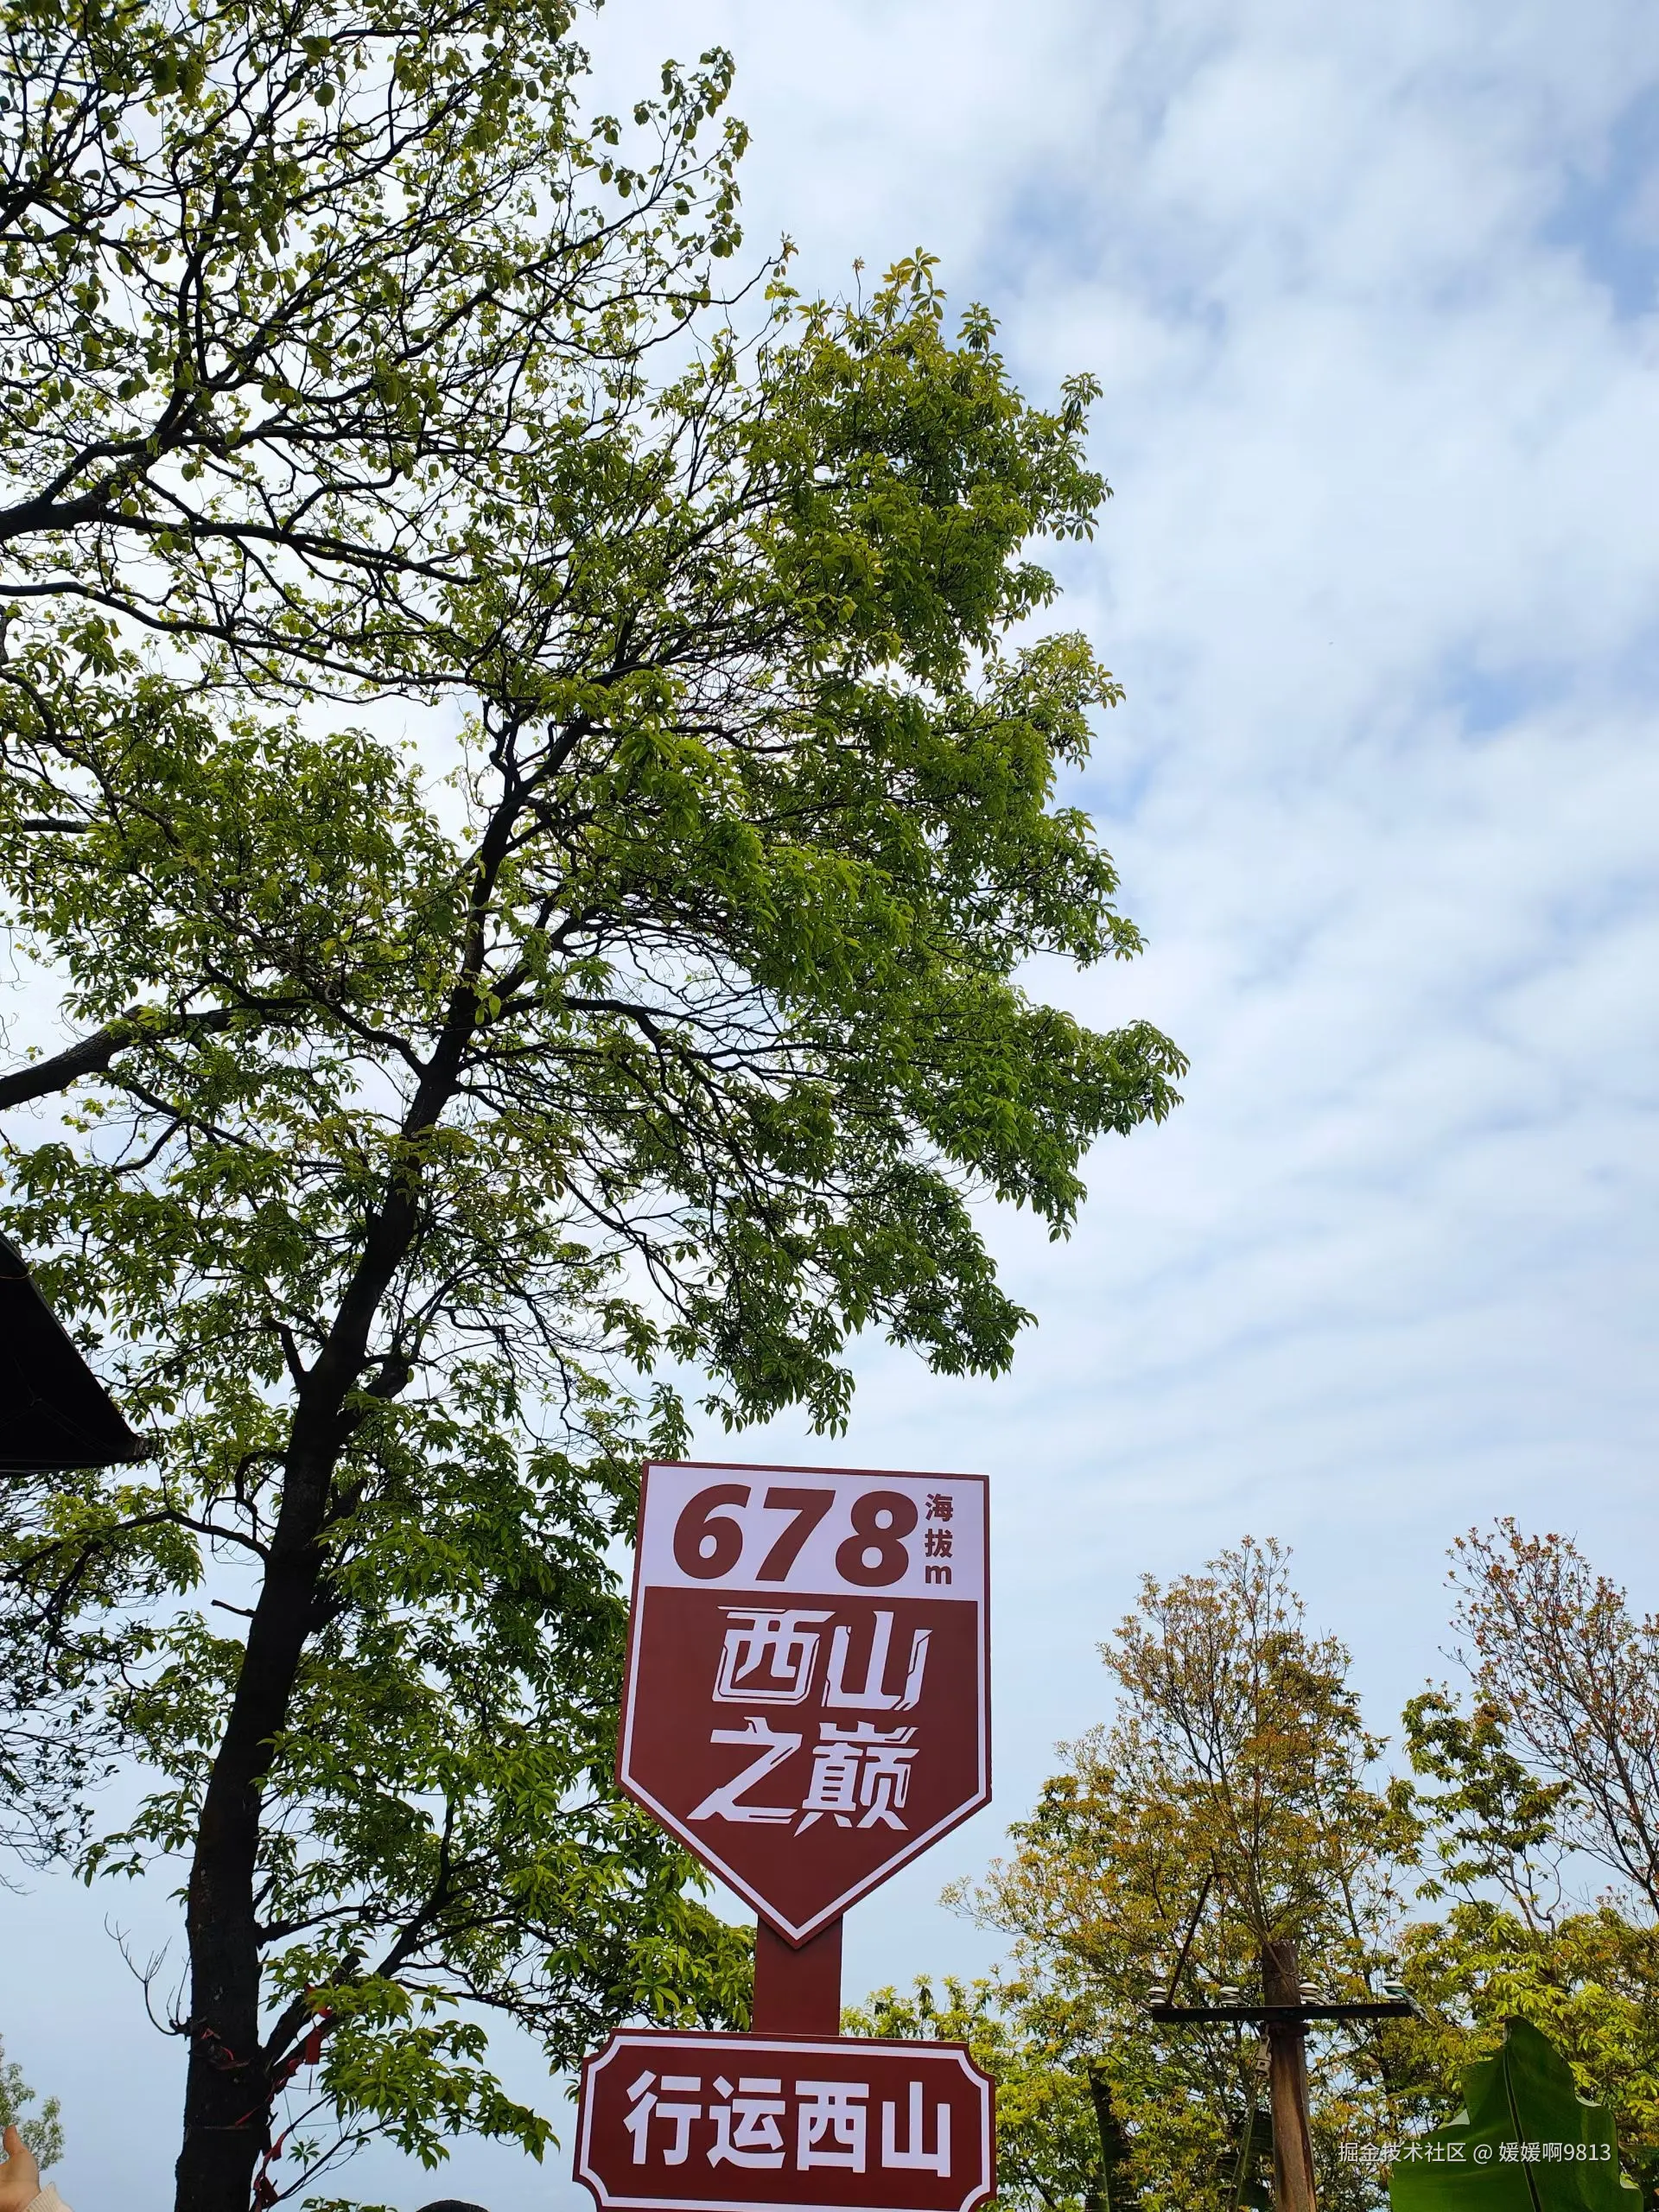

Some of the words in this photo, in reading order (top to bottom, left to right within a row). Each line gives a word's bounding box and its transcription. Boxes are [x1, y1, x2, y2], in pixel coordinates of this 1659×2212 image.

[672, 1484, 918, 1588] 678
[711, 1605, 933, 1712] 西山
[686, 1717, 920, 1837] 之巅
[623, 2069, 951, 2177] 行运西山
